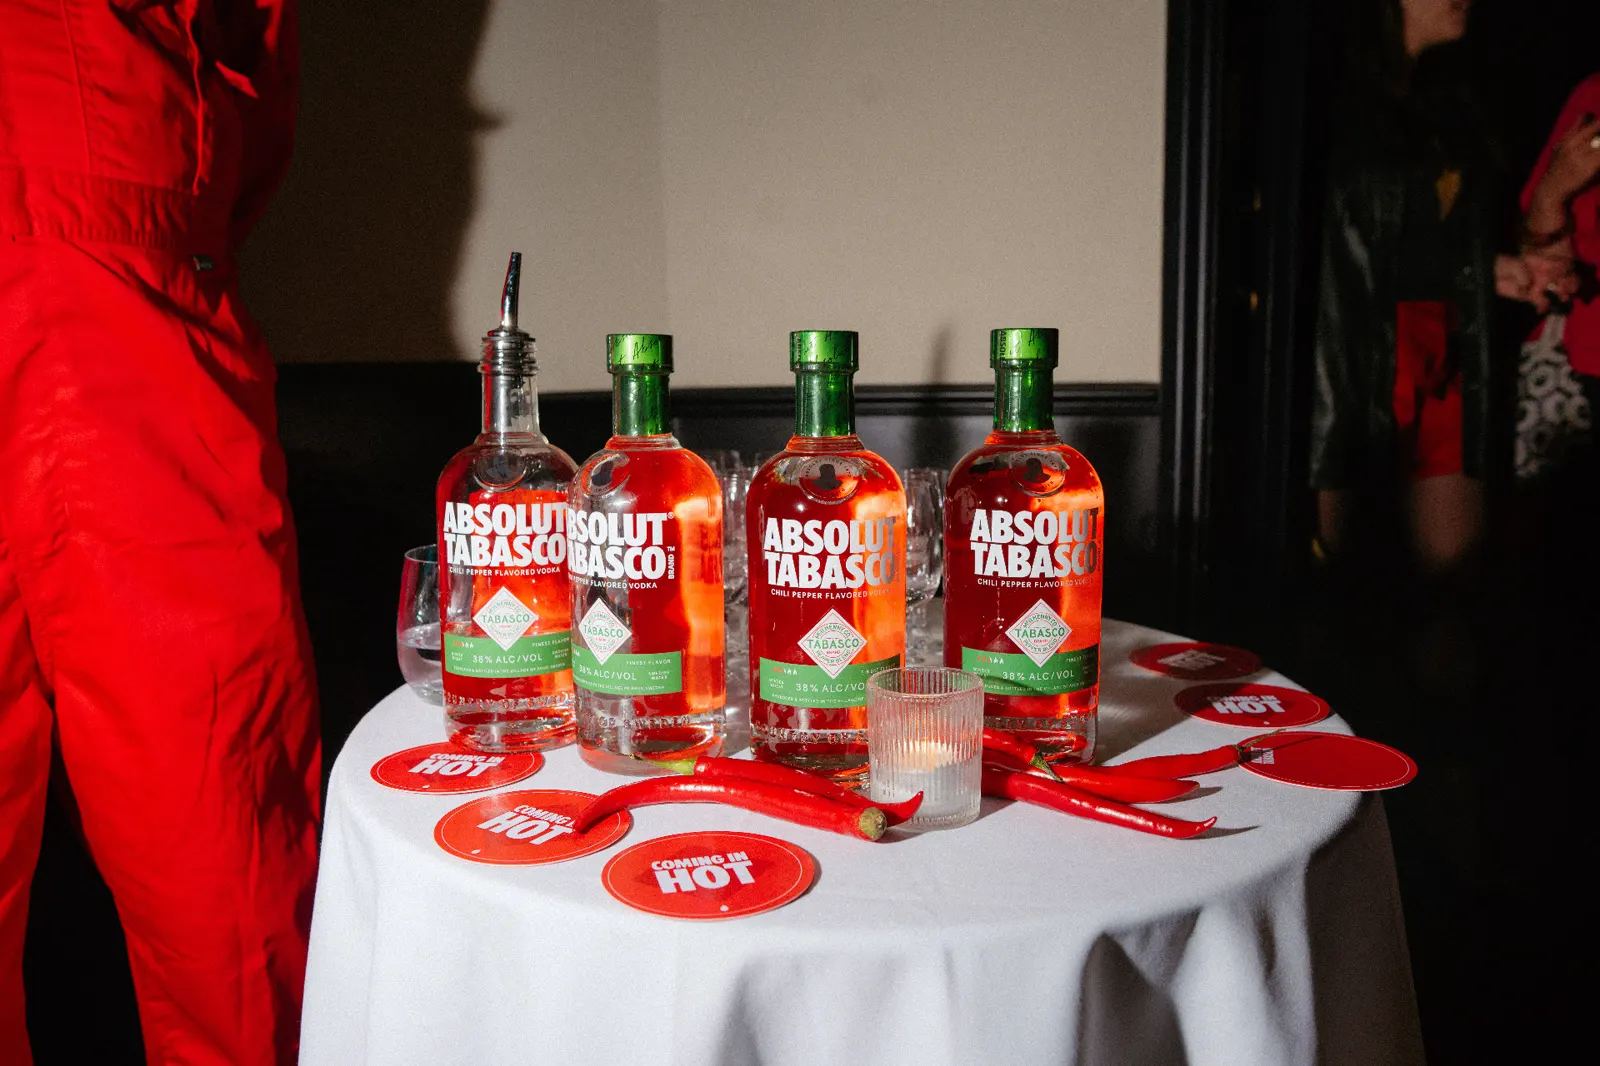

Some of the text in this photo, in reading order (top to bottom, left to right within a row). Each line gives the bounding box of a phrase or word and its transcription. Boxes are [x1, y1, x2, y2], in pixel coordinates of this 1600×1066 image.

[443, 501, 568, 536] ABSOLUT
[566, 507, 667, 547] BSOLUT
[969, 507, 1099, 545] ABSOLUT
[763, 516, 896, 555] ABSOLUT
[443, 532, 567, 568] TABASCO
[566, 540, 667, 580] ABASCO
[970, 541, 1097, 579] TABASCO
[449, 566, 561, 577] CHILI PEPPER FLAVORED VODKA
[764, 550, 895, 589] TABASCO
[590, 579, 628, 589] FLAVORED
[629, 581, 658, 589] VODKA
[977, 578, 998, 587] CHILI
[1000, 579, 1032, 588] PEPPER
[771, 588, 790, 597] CHILI
[792, 590, 823, 599] PEPPER
[825, 590, 868, 600] FLAVORED
[481, 613, 530, 625] TABASCO
[583, 625, 624, 639] TABASCO
[1014, 626, 1065, 639] TABASCO
[806, 638, 860, 650] TABASCO
[495, 653, 543, 664] ALC/VOL
[593, 669, 637, 681] ALC/VOL
[1002, 671, 1026, 681] 38%
[1028, 669, 1075, 681] ALC/VOL
[795, 682, 865, 693] 38% ALC/VO
[1211, 700, 1286, 714] HOT
[429, 753, 506, 764] COMING IN
[408, 759, 500, 777] HOT
[513, 804, 571, 826] COMING
[476, 811, 575, 845] HOT
[651, 851, 749, 871] COMING IN
[654, 861, 756, 895] HOT
